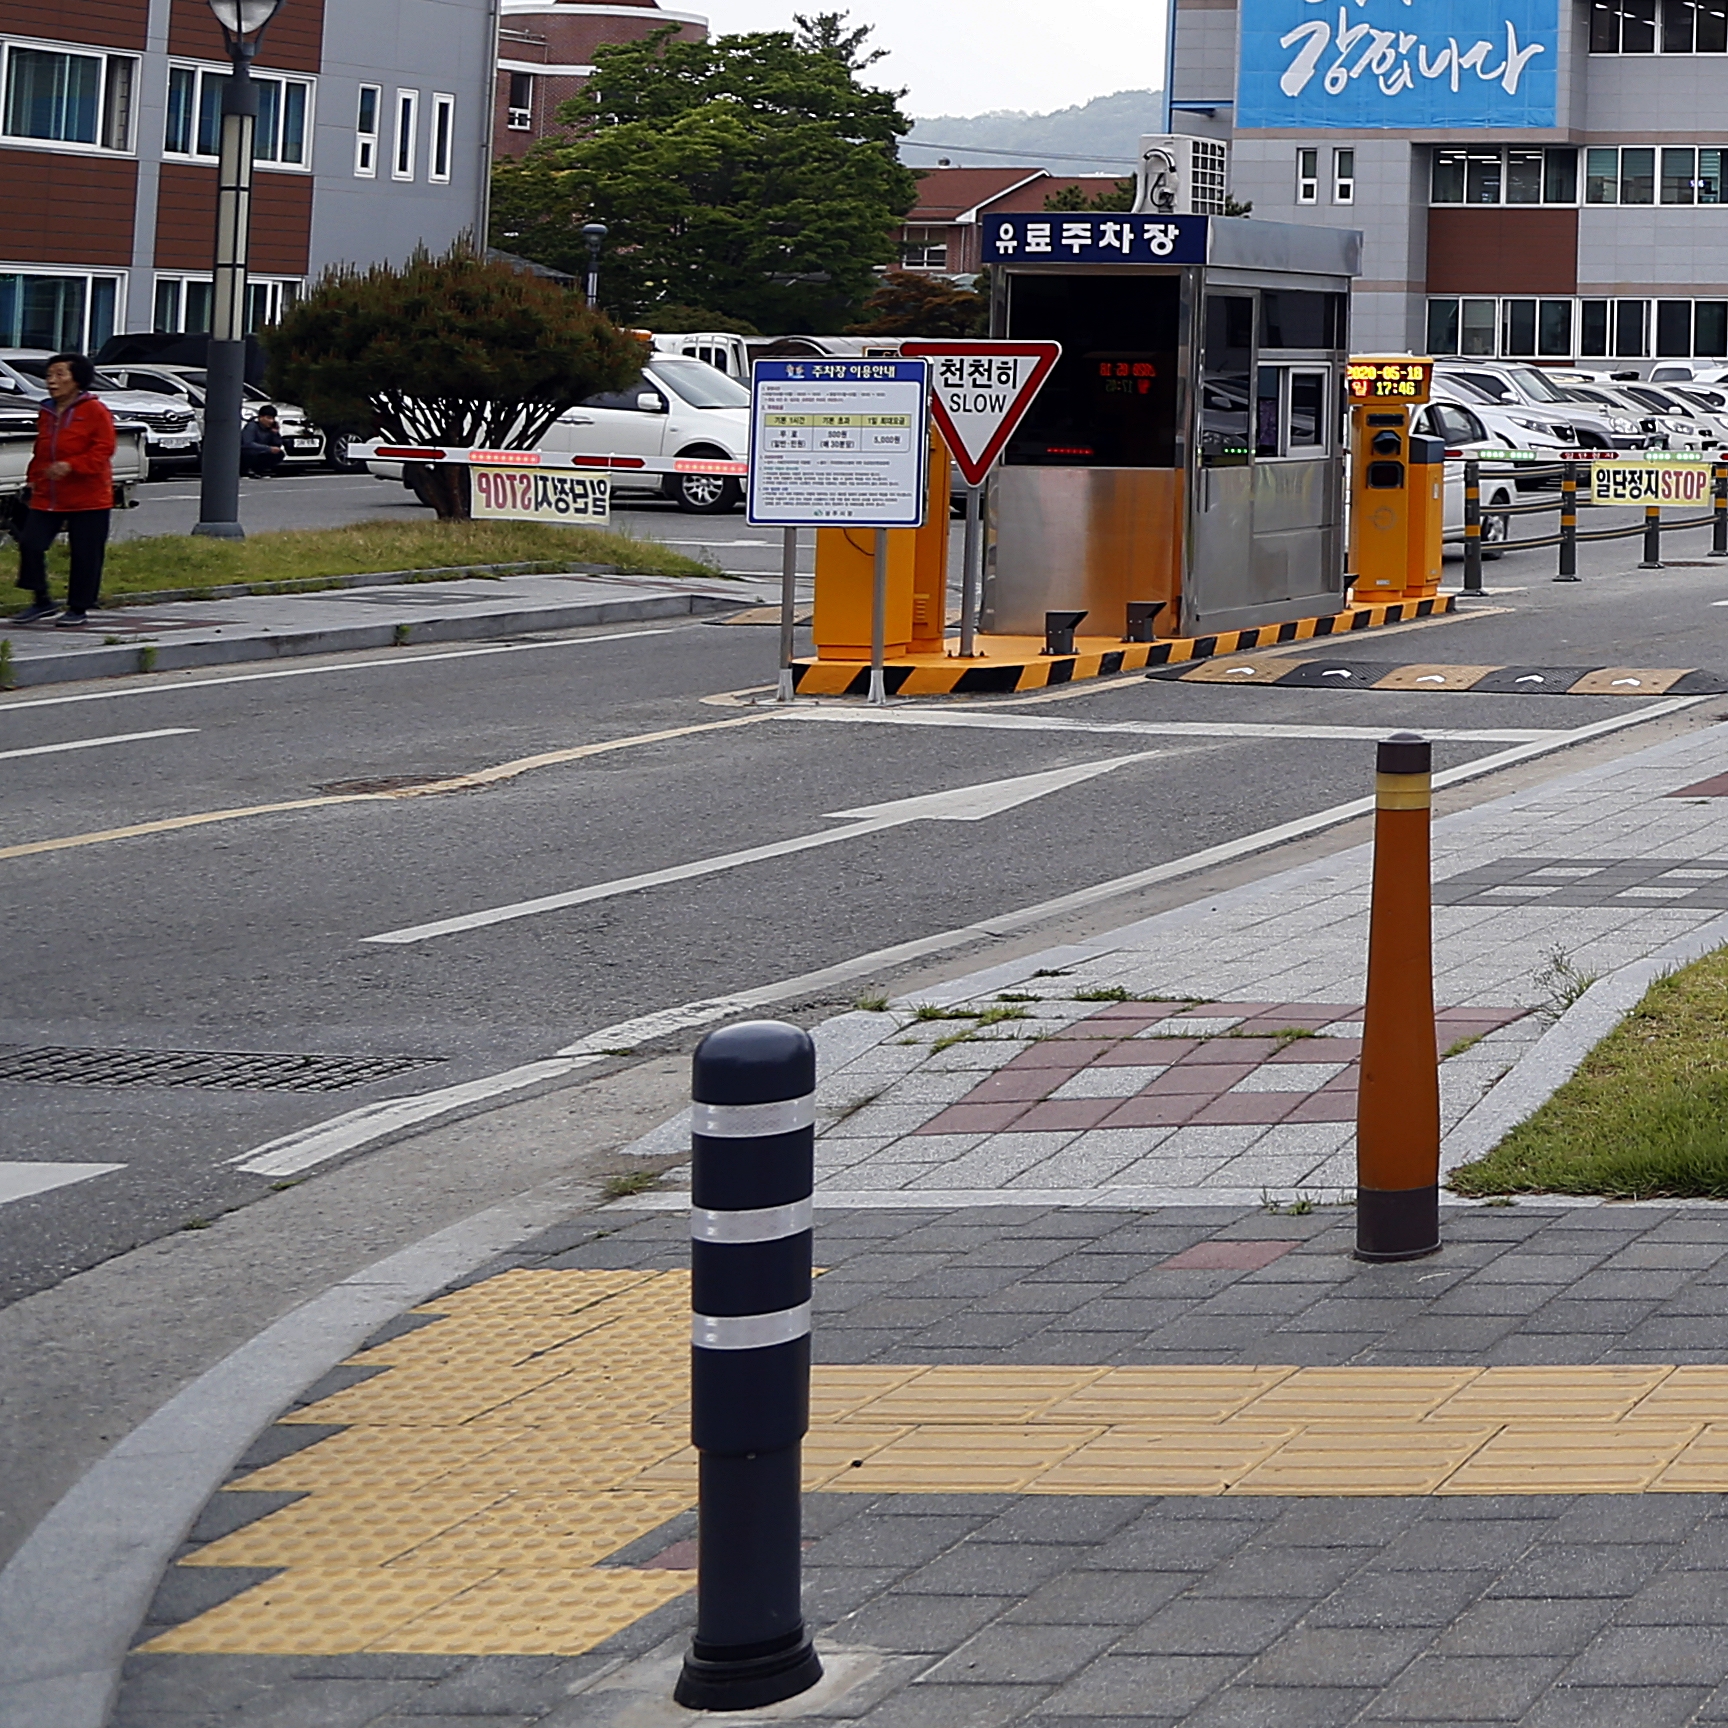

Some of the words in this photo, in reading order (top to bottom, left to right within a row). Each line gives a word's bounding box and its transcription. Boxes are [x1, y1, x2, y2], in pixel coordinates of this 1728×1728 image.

[995, 221, 1180, 256] 유료주차장
[811, 364, 847, 379] 주차장
[849, 364, 896, 379] 이용안내
[939, 358, 1018, 390] 천천히
[1375, 380, 1416, 396] 17:46
[949, 393, 1007, 414] SLOW
